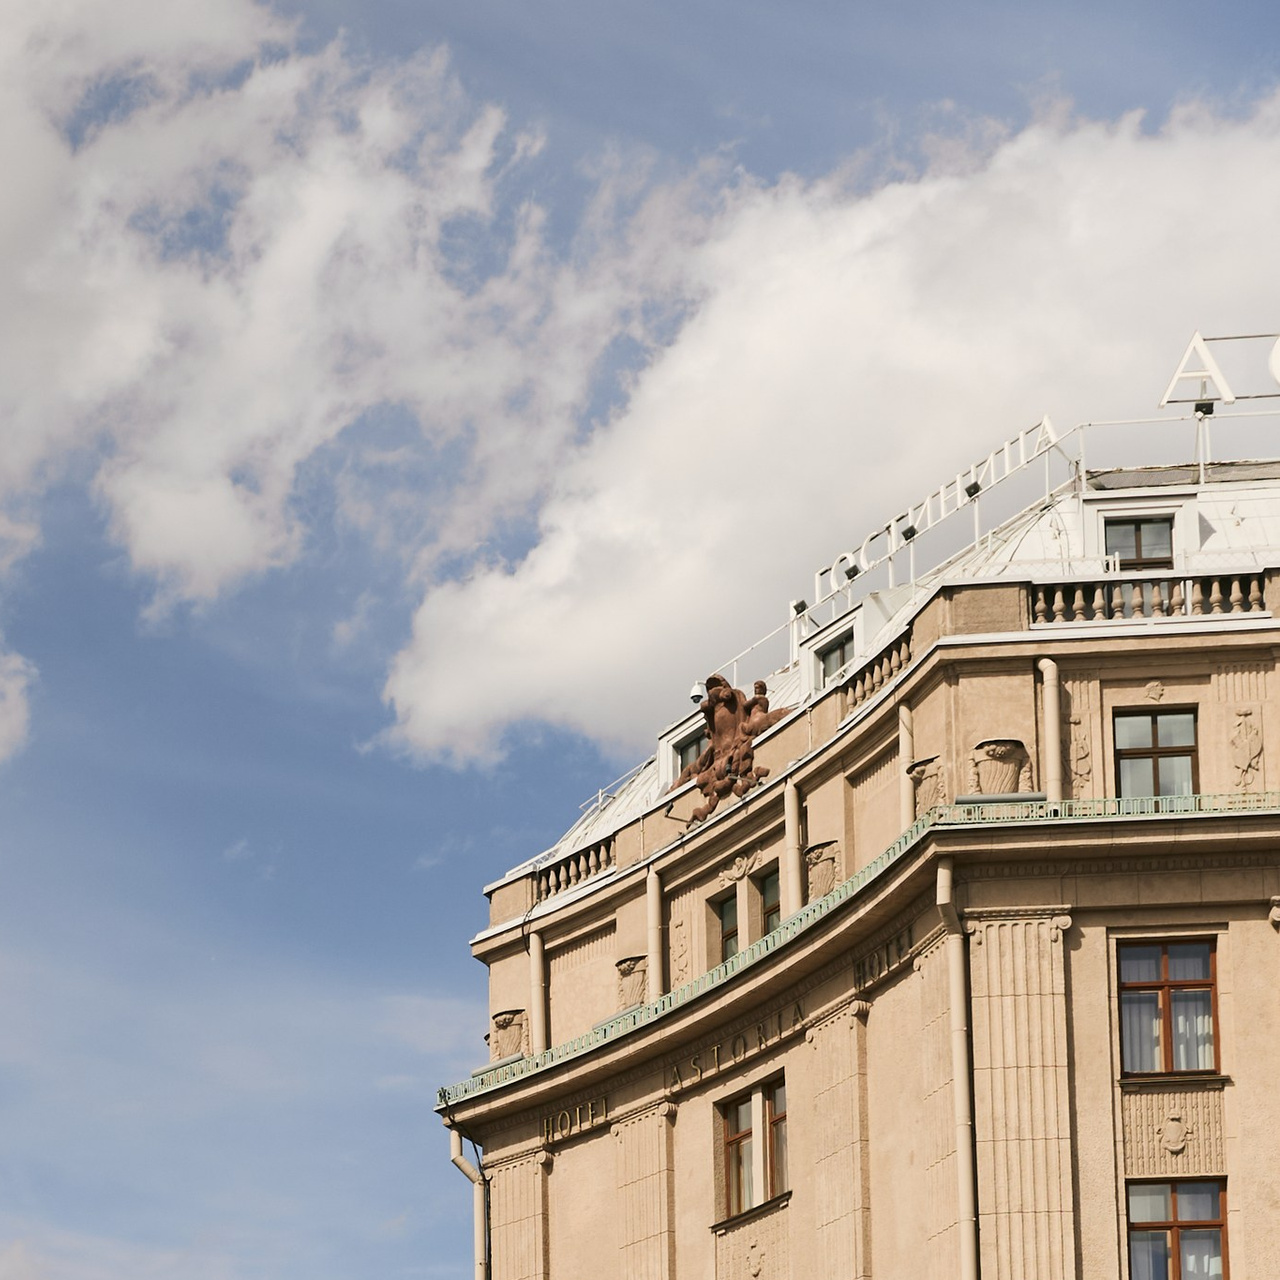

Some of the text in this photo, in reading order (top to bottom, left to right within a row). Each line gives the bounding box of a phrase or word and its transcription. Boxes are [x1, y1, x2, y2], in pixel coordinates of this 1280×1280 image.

[1158, 330, 1280, 408] А
[543, 1097, 609, 1144] HOTEL
[670, 1003, 806, 1092] ASTORIA
